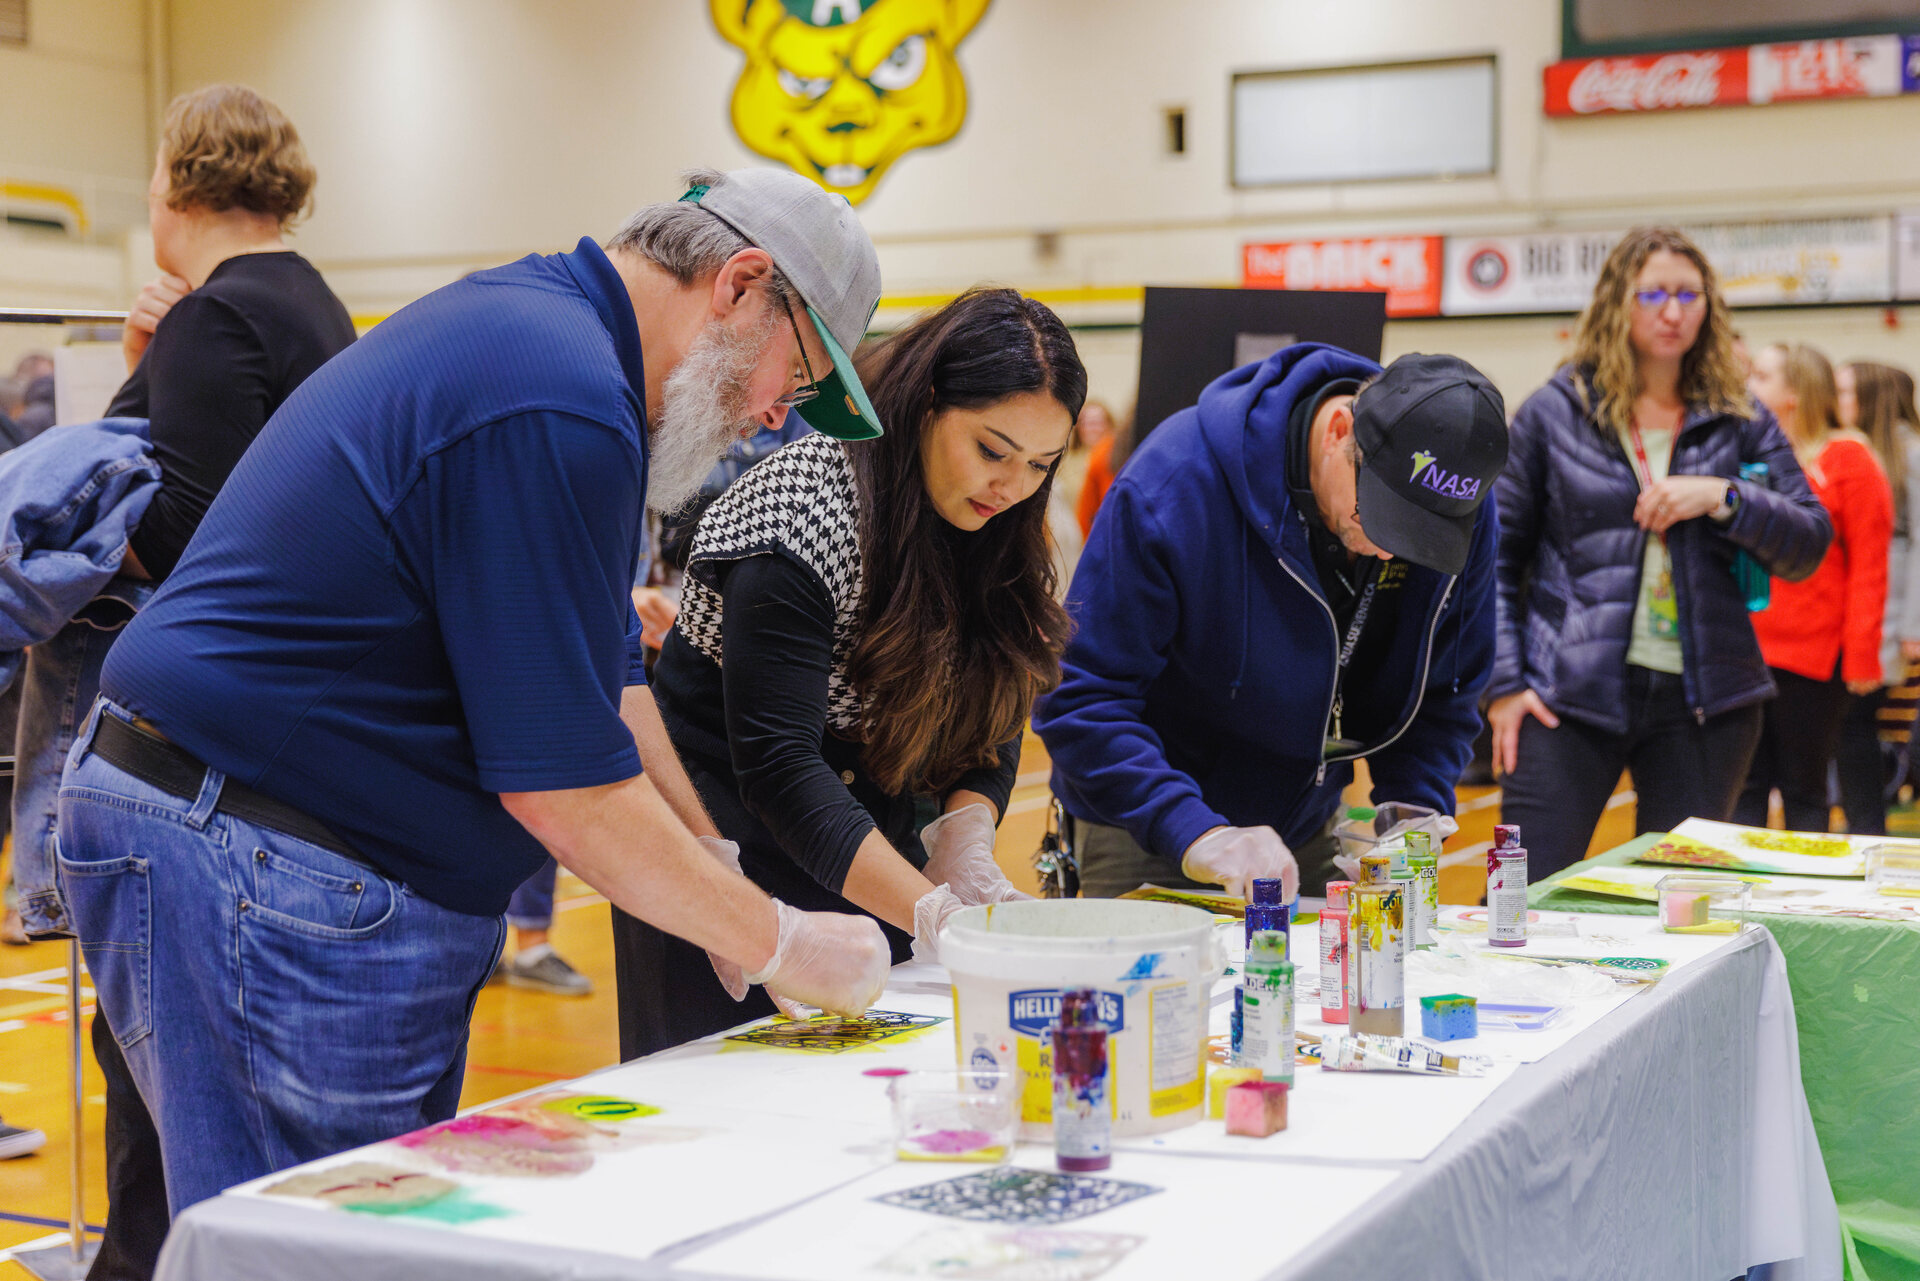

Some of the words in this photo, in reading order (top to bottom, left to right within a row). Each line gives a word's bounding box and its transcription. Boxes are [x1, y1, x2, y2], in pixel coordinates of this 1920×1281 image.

[1284, 239, 1427, 290] BRICK
[1522, 241, 1564, 275] BIG
[1423, 463, 1481, 497] NASA
[1013, 994, 1119, 1021] HELL'S
